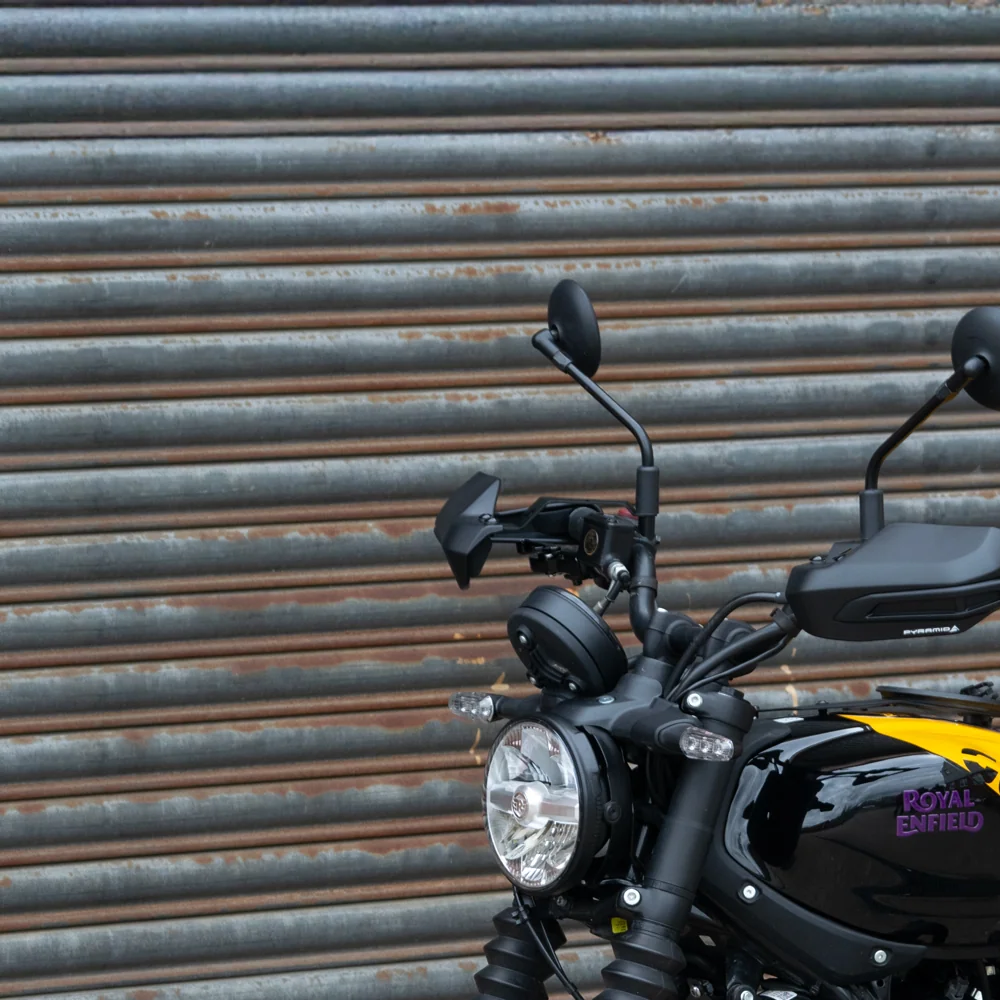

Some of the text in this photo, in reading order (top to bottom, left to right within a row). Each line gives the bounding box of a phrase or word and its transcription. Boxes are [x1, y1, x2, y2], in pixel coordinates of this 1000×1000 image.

[903, 626, 951, 635] PYRAMID
[903, 789, 975, 813] ROYAL
[896, 811, 984, 837] ENFIELD
